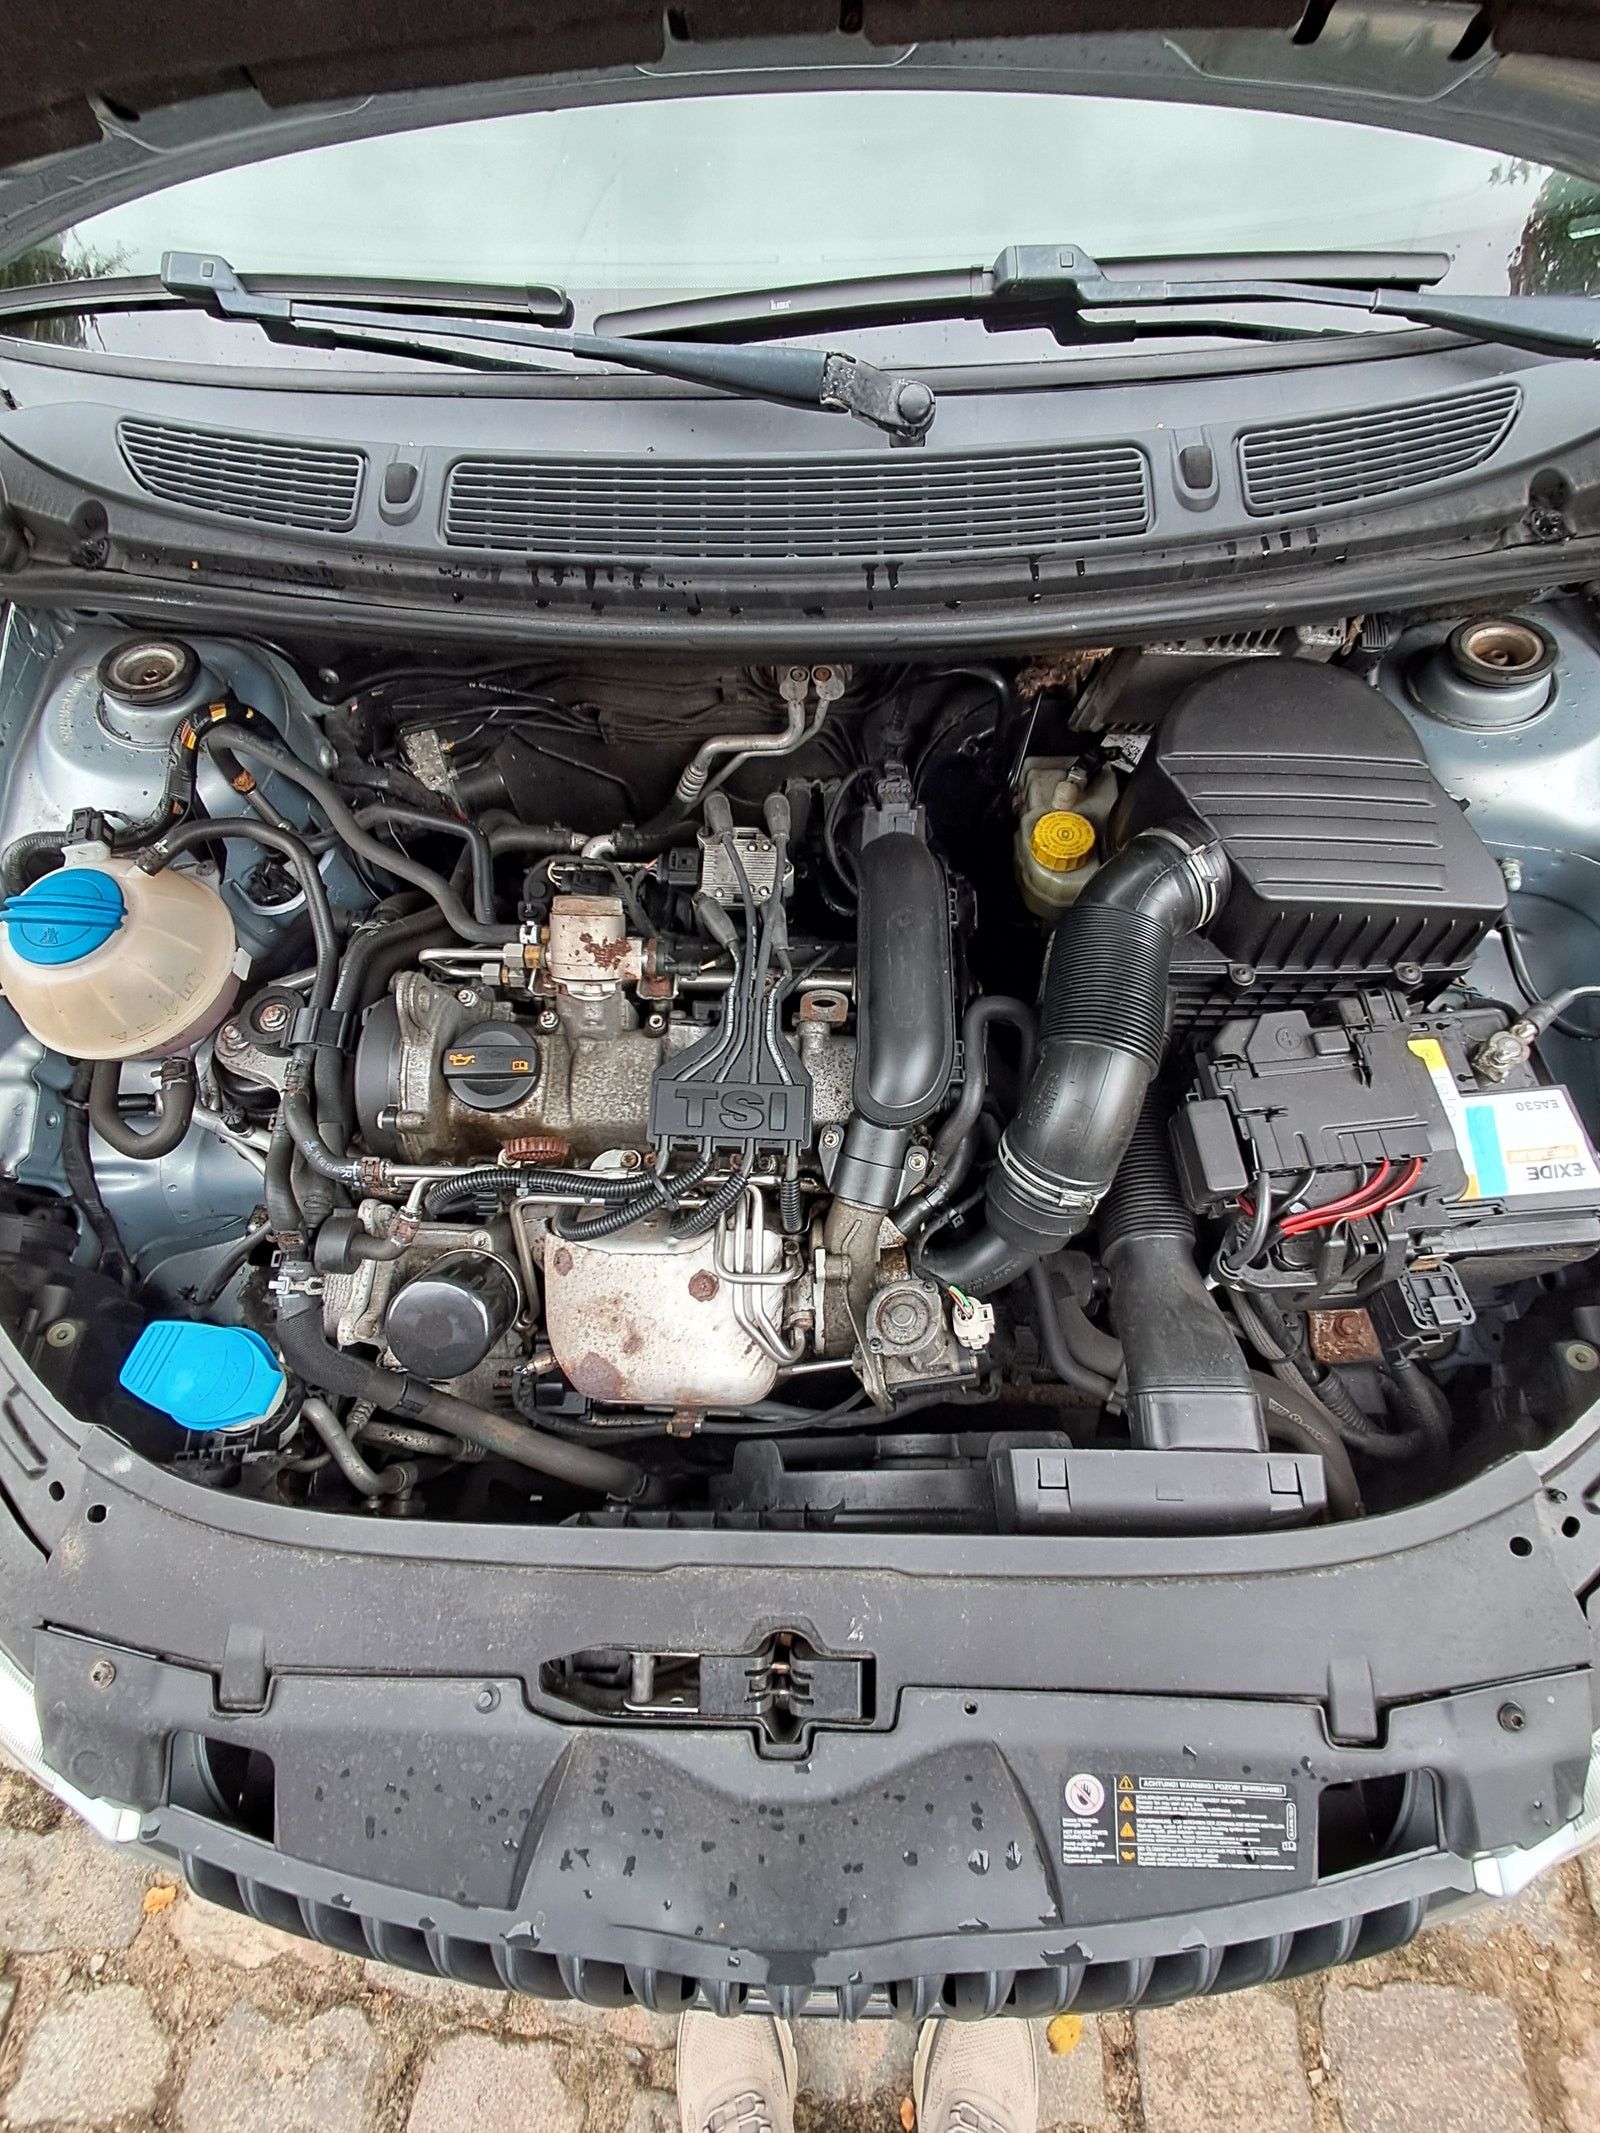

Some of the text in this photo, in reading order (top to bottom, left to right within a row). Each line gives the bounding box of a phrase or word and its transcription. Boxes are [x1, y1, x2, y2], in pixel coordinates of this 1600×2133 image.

[675, 1088, 787, 1131] TSI
[1515, 1099, 1560, 1111] EA530
[1527, 1162, 1586, 1180] EXIDE
[1143, 1780, 1178, 1788] ACHTUNG!
[1179, 1781, 1213, 1790] WARNING!
